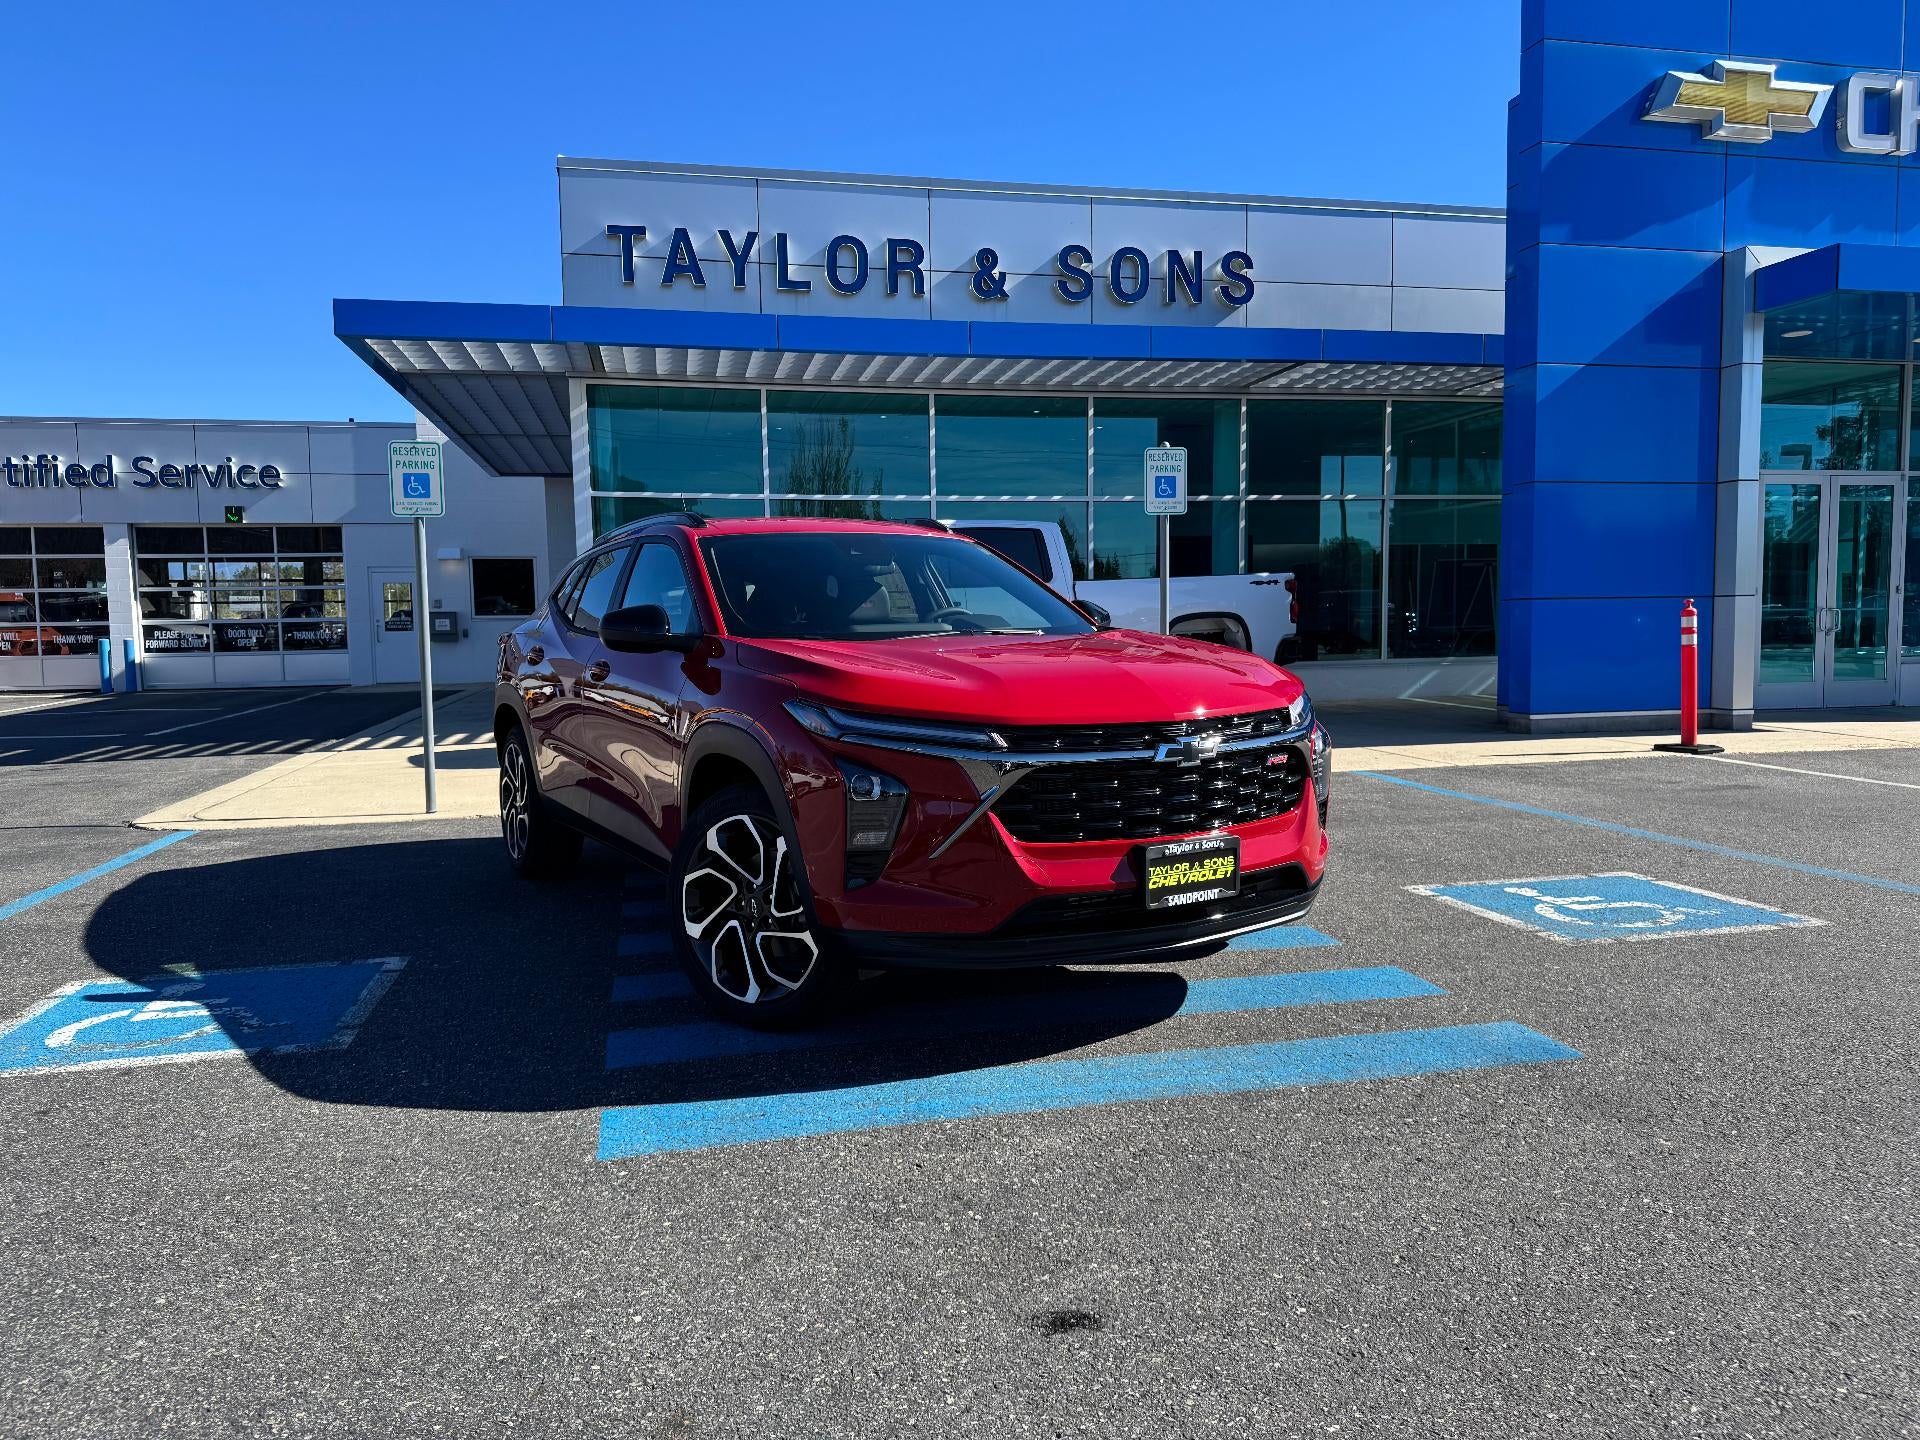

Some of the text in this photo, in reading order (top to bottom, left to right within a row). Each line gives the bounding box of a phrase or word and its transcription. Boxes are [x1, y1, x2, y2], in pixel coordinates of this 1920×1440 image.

[605, 224, 1255, 306] TAYLOR & SONS
[392, 446, 437, 457] RESERVED
[1148, 453, 1183, 462] RESERVED
[395, 460, 435, 470] PARKING
[1149, 464, 1182, 473] PARKING
[131, 455, 283, 489] Service
[154, 630, 180, 640] PLEASE
[228, 629, 246, 638] DOOR
[293, 631, 315, 640] THANK
[53, 635, 94, 644] THANK YOU!
[145, 639, 207, 649] FORWARD SLOWLY
[237, 638, 256, 647] OPEN
[1168, 843, 1193, 855] Taylor
[1201, 839, 1220, 849] Sons
[1148, 856, 1235, 877] TAYLOR & SONS
[1148, 866, 1235, 890] CHEVROLET
[1167, 887, 1220, 907] SANDPOINT
